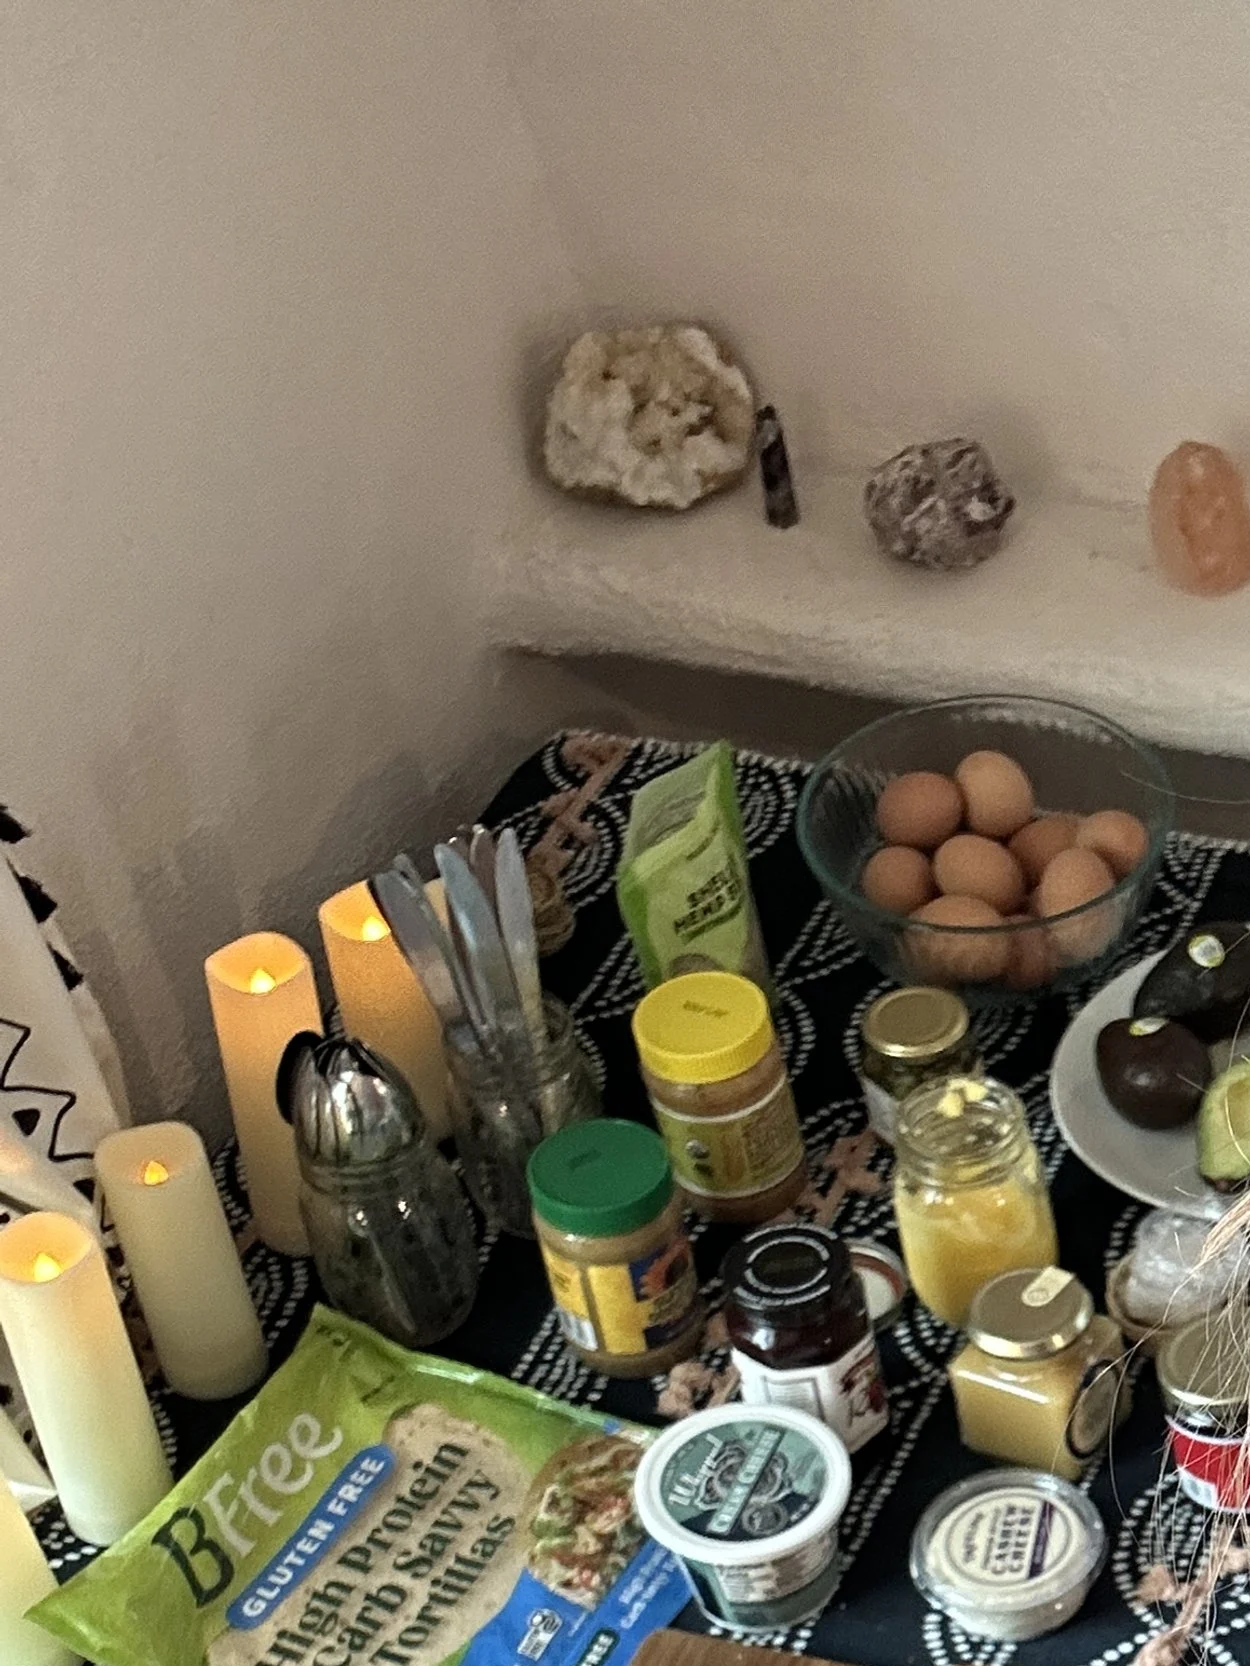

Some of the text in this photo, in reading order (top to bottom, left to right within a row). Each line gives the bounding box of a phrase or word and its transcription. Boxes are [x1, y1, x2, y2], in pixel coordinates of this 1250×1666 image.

[152, 1413, 344, 1609] BFree
[241, 1456, 386, 1617] GLUTEN FREE
[336, 1443, 471, 1575] Protein
[392, 1468, 501, 1580] Savvy
[990, 1503, 1017, 1576] CASHEW
[1007, 1505, 1036, 1574] CHEESE
